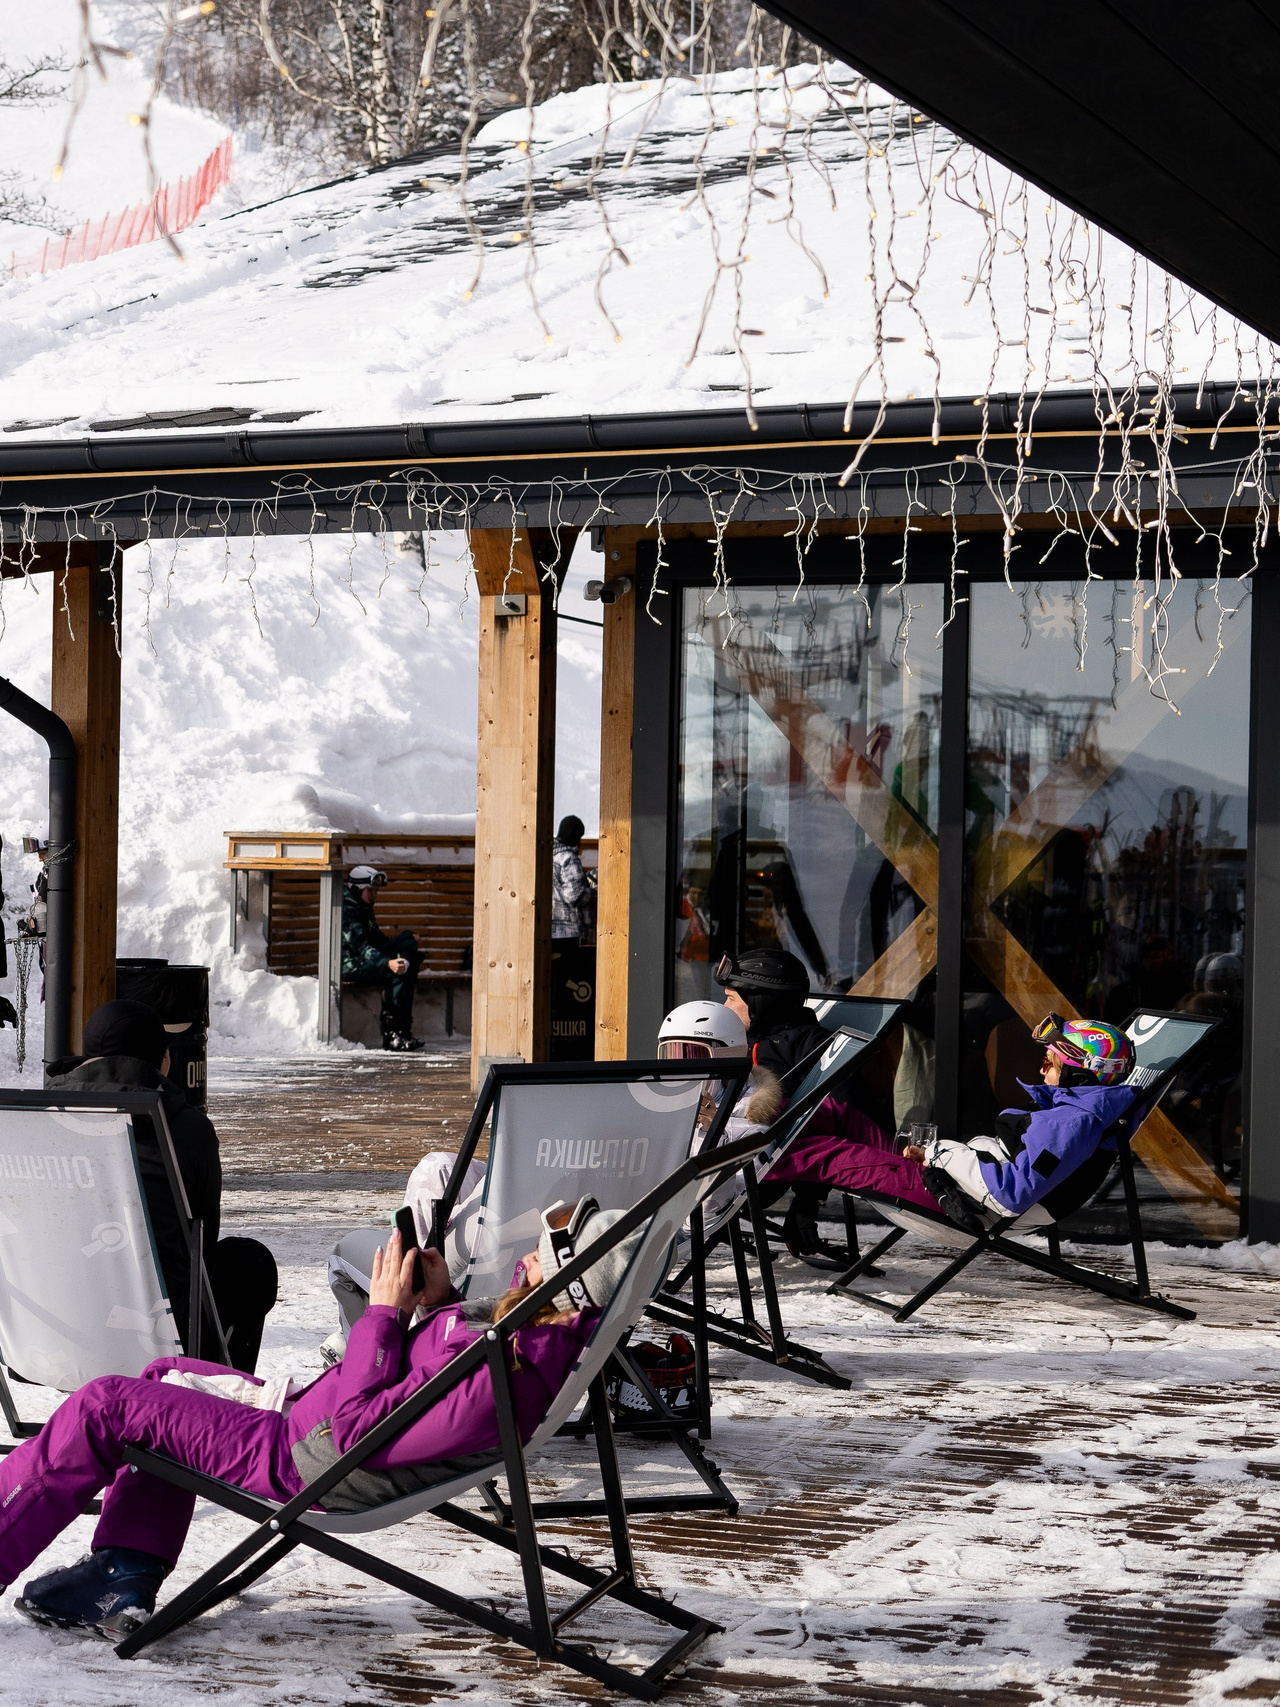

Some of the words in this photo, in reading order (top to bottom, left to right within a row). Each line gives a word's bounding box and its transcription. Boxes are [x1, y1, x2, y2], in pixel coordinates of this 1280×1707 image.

[740, 971, 784, 985] CARRERA
[552, 1020, 587, 1036] УШКА
[693, 1030, 714, 1038] SINNER
[557, 1246, 593, 1312] uex
